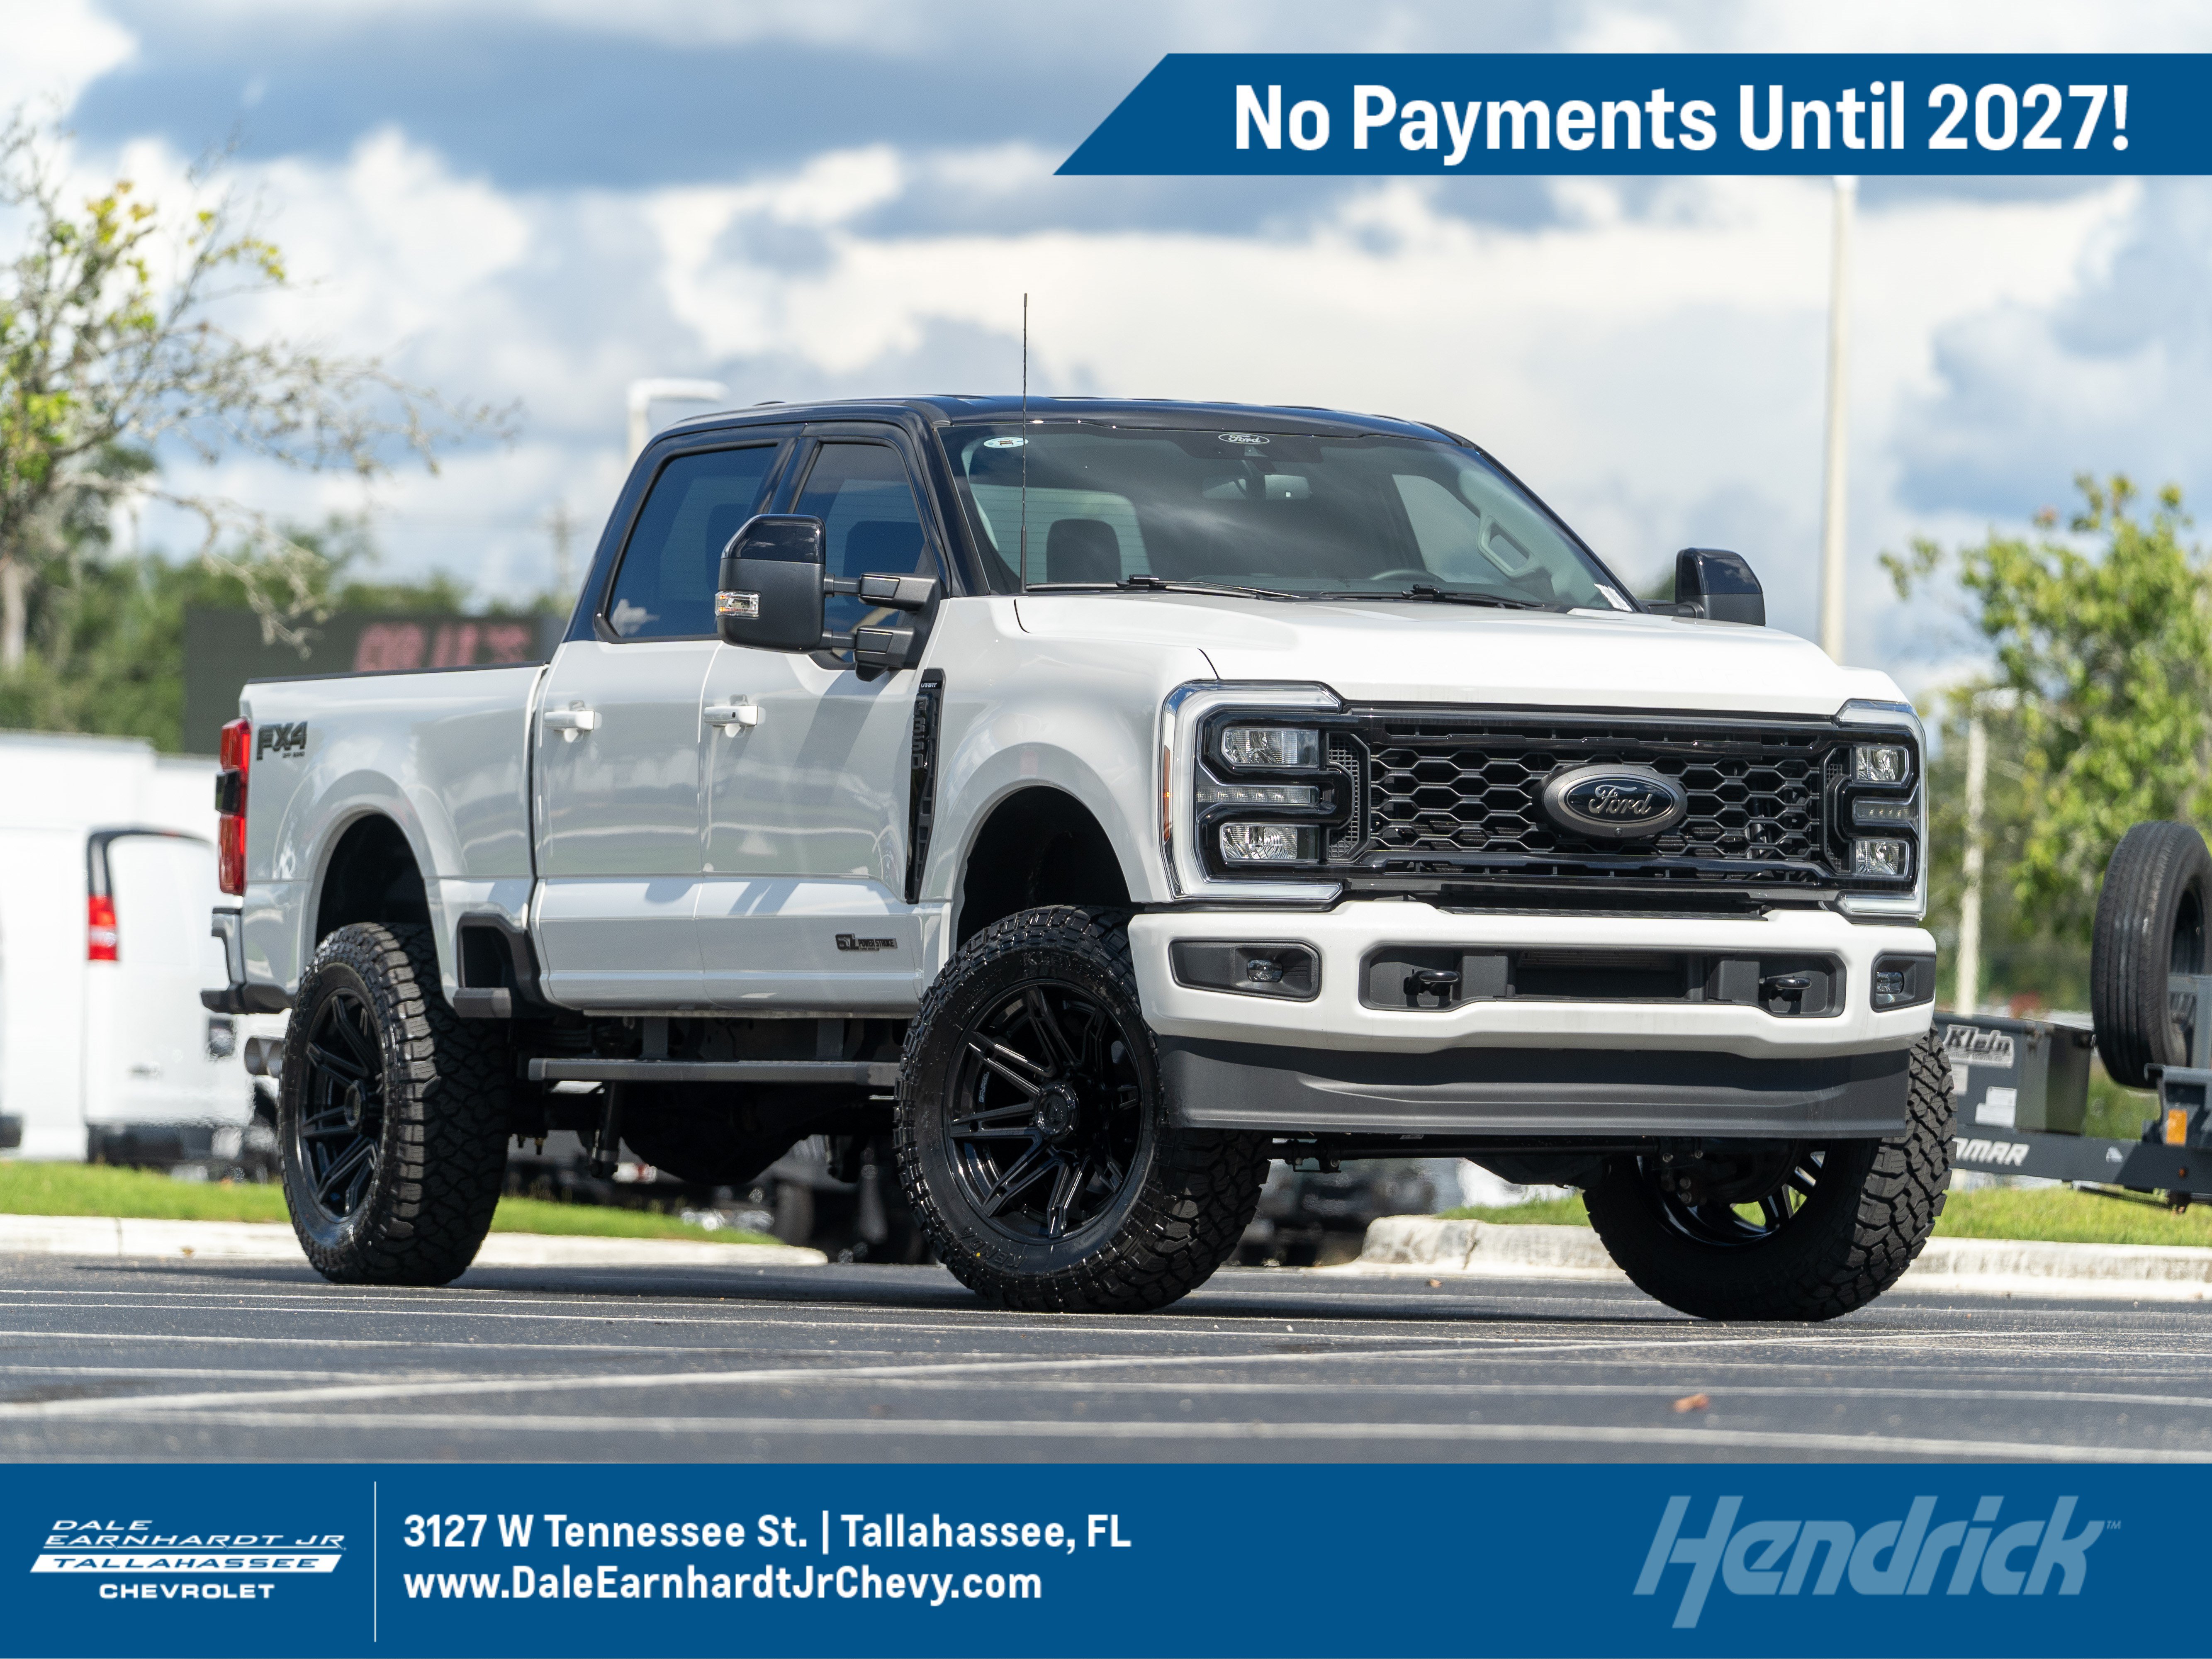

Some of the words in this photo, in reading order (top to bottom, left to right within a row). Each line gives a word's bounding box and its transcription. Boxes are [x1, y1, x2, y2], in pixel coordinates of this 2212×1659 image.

[1228, 434, 1261, 443] Ford
[256, 721, 307, 760] FX4
[1588, 784, 1653, 814] Ford
[858, 939, 875, 947] POWER
[875, 939, 895, 947] STROKE
[959, 1226, 1027, 1269] KENDA
